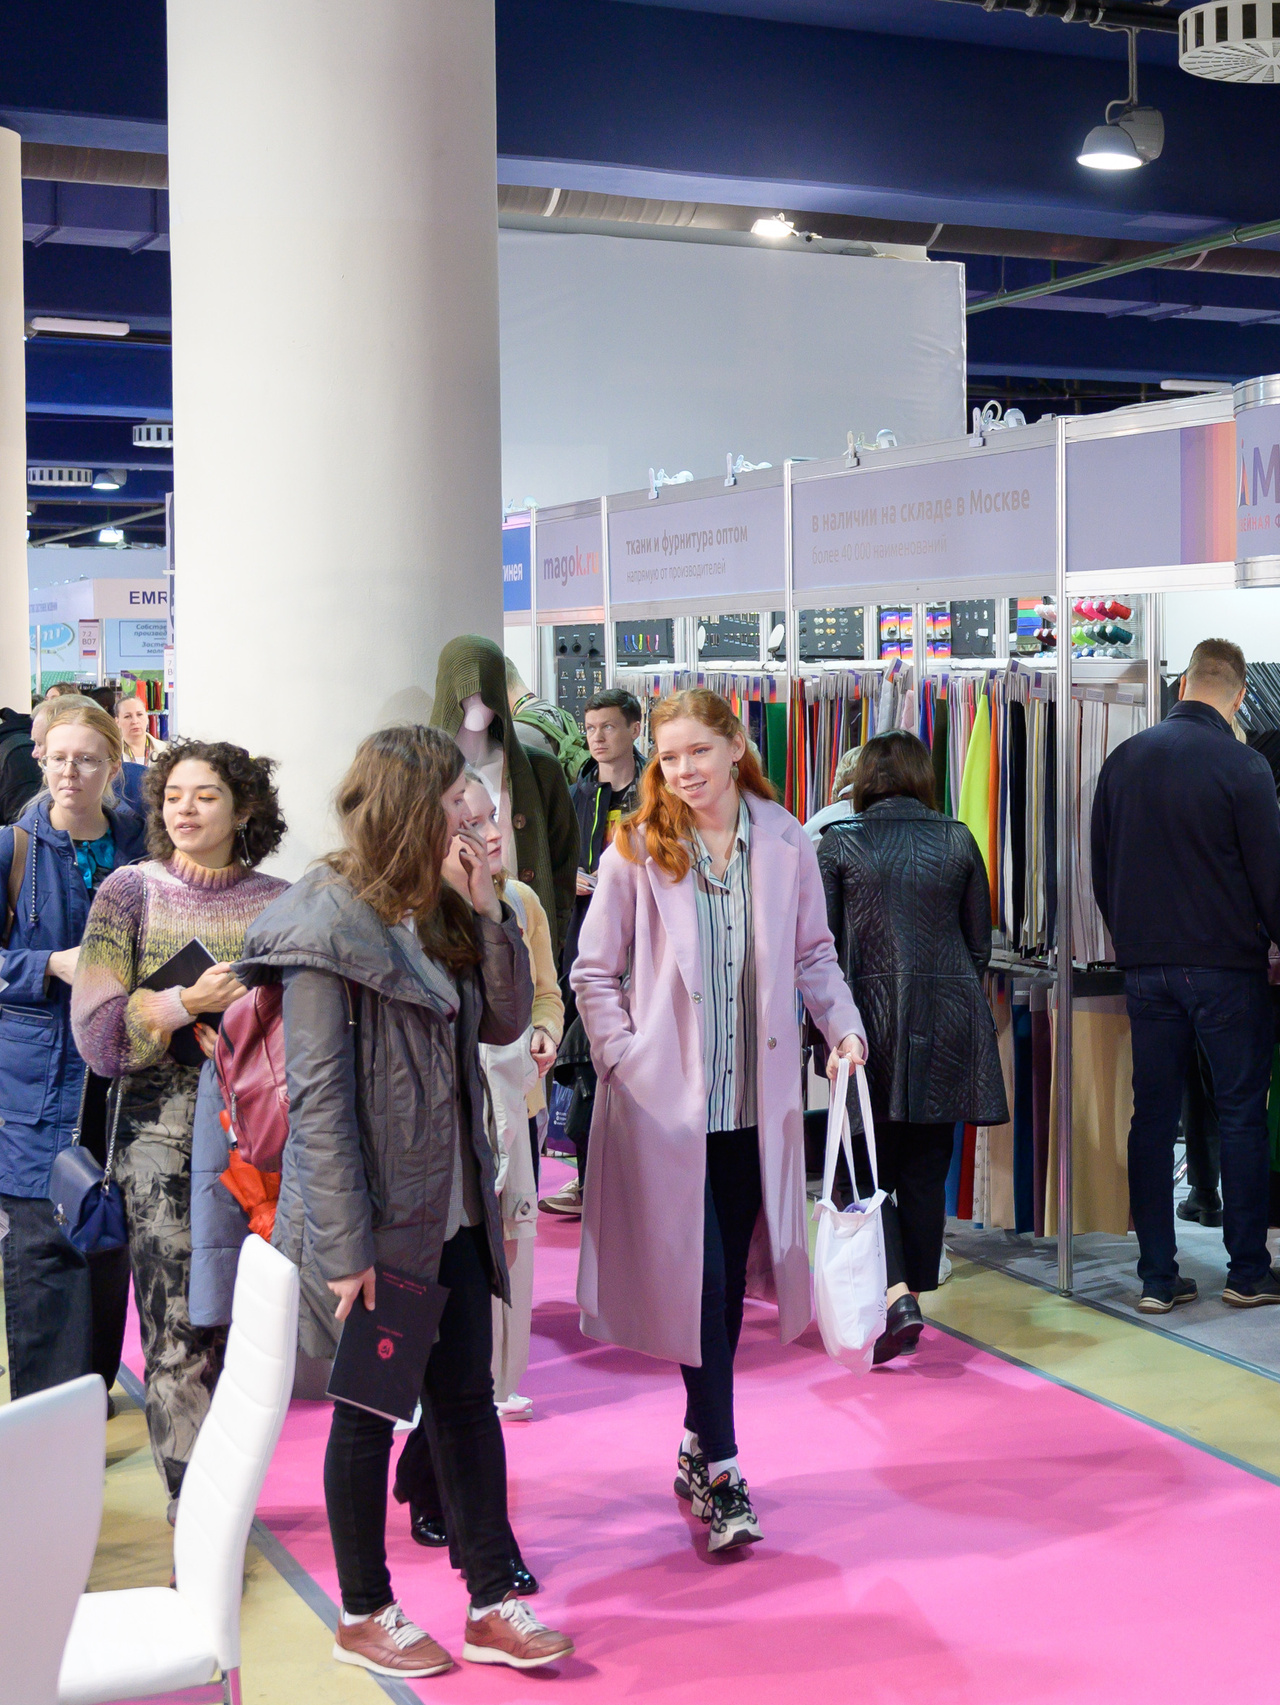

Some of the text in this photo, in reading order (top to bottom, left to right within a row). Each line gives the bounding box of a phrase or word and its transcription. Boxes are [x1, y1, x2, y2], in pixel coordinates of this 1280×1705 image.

[812, 488, 1031, 533] в наличии на складе в Москве
[626, 525, 748, 557] ткани и фурнитура оптом
[812, 534, 947, 565] более 40 000 наименований
[543, 545, 600, 587] magok.ru
[626, 558, 726, 585] напрямую от производителей
